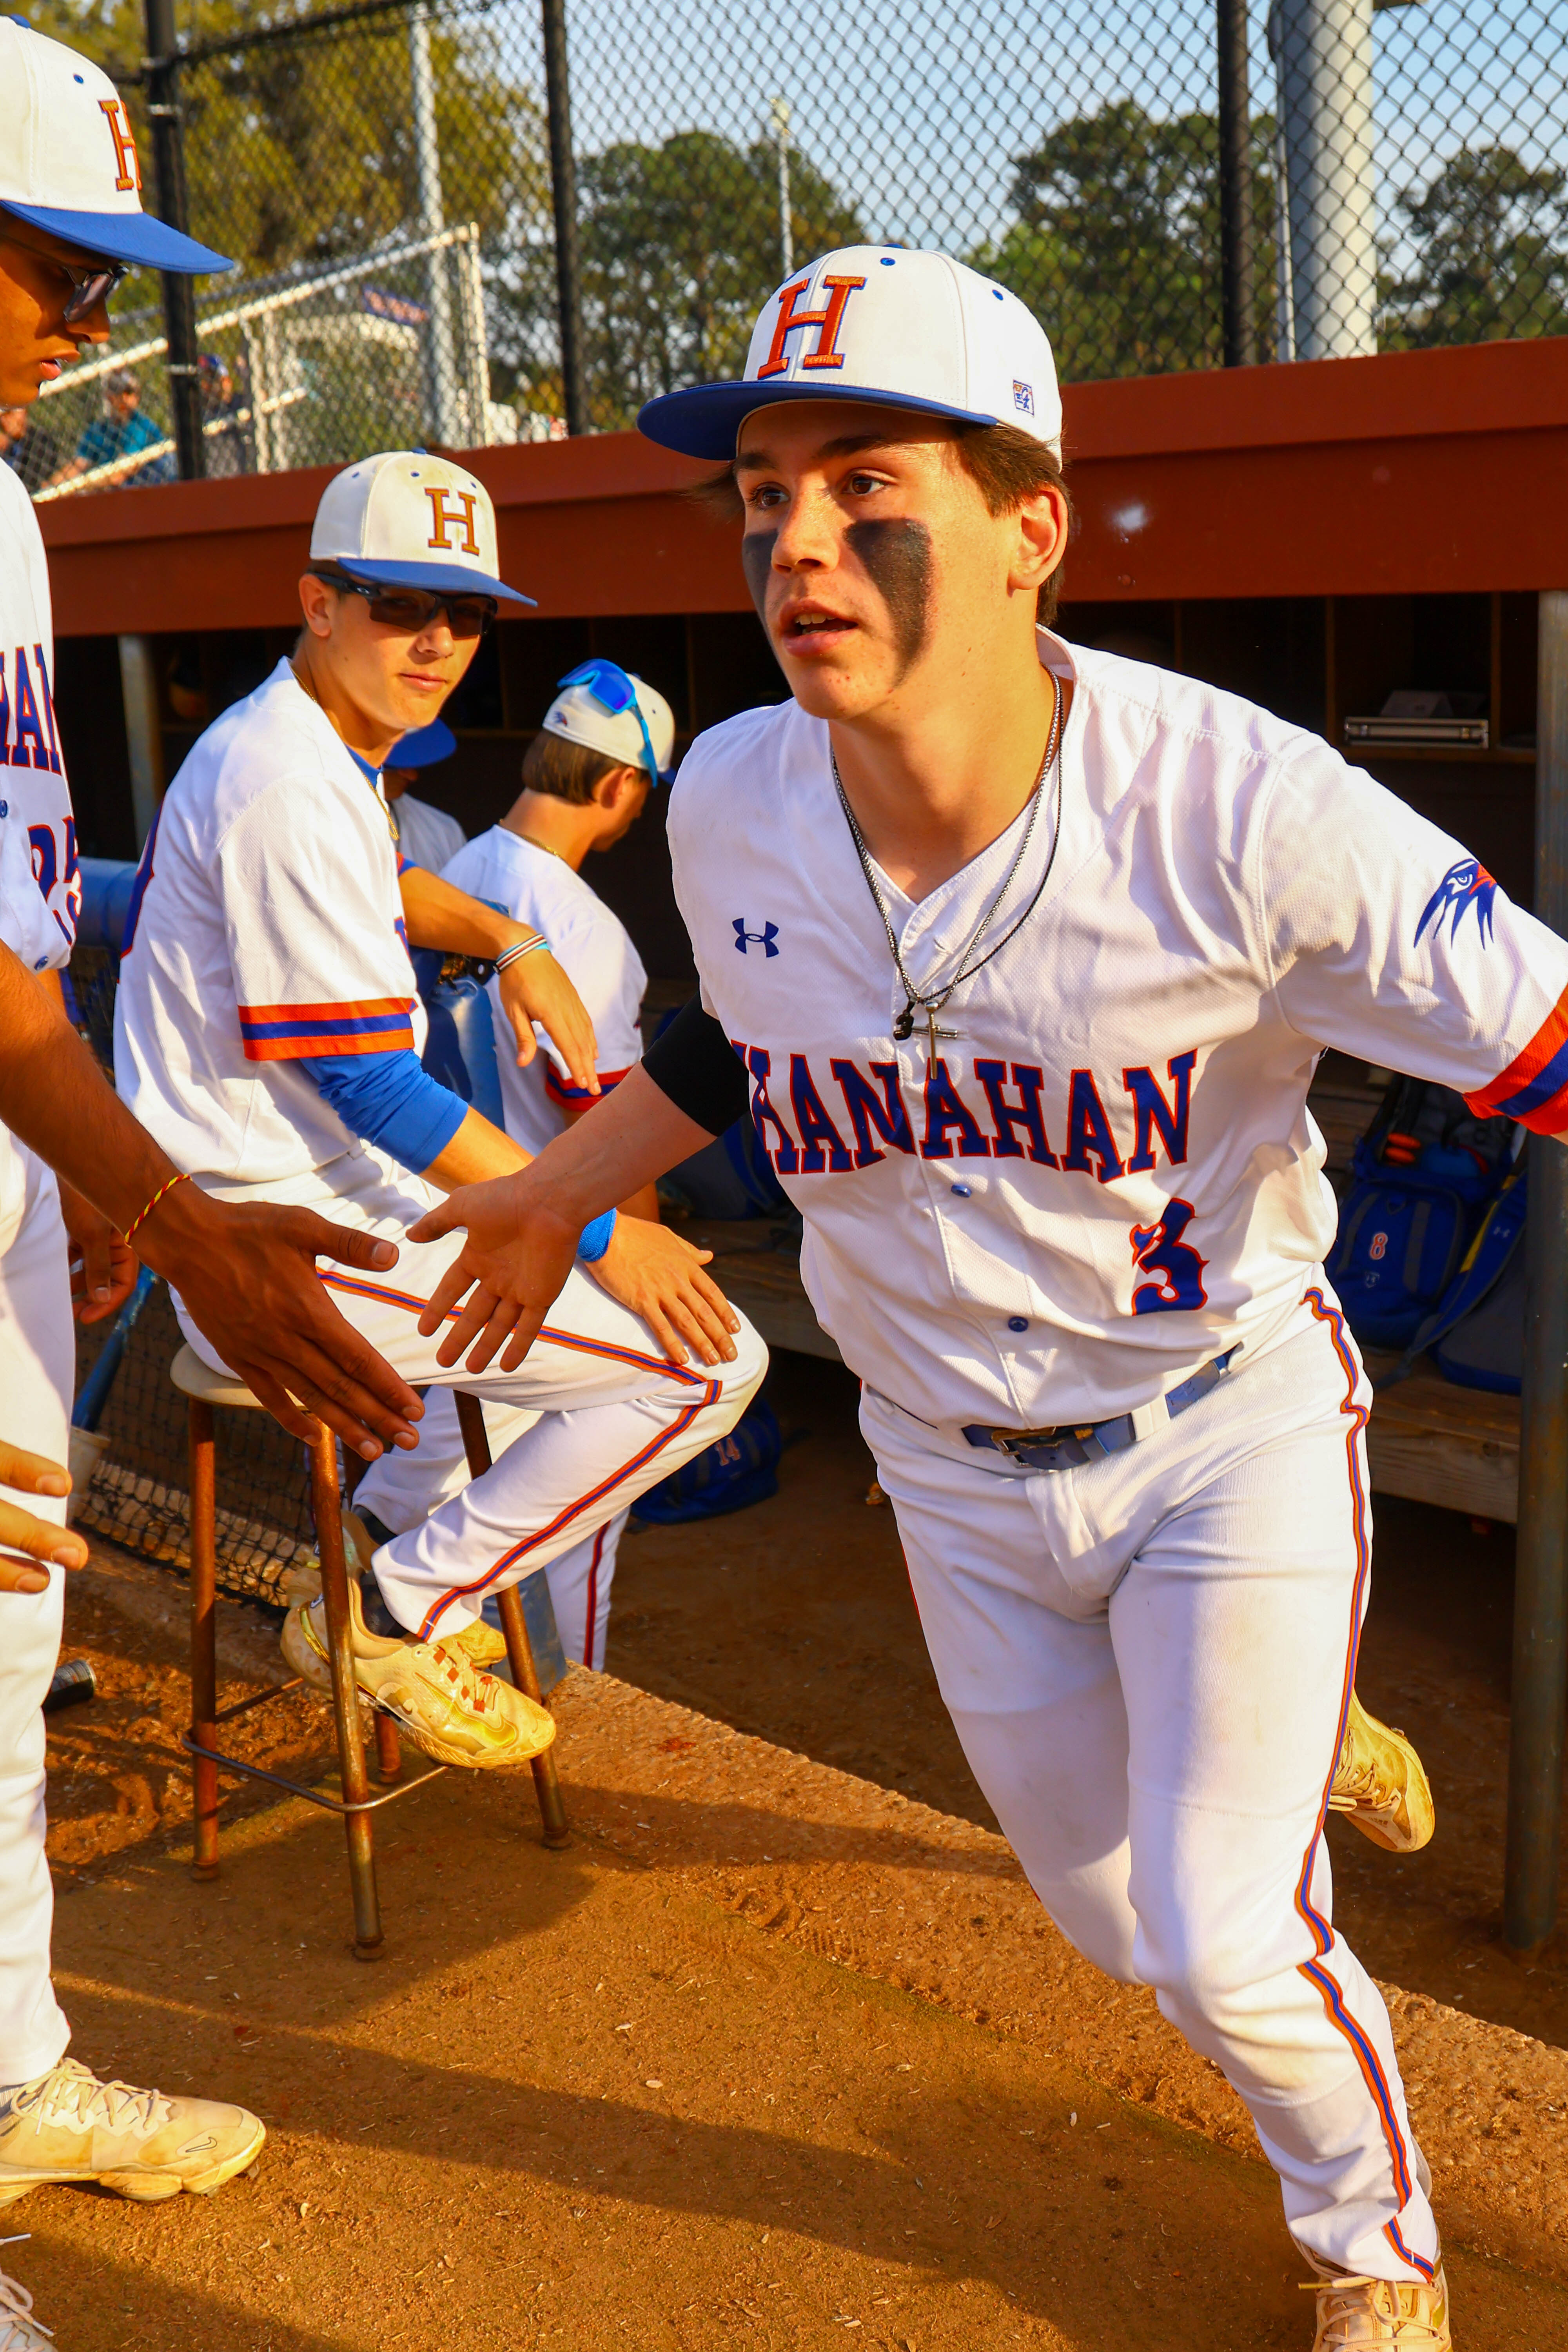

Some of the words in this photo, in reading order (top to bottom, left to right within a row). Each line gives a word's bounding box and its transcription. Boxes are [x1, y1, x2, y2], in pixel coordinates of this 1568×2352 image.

[757, 275, 867, 380] H
[425, 488, 479, 557] H
[1129, 1197, 1210, 1316] 3
[1370, 1232, 1388, 1260] 8
[714, 1437, 741, 1466] 14
